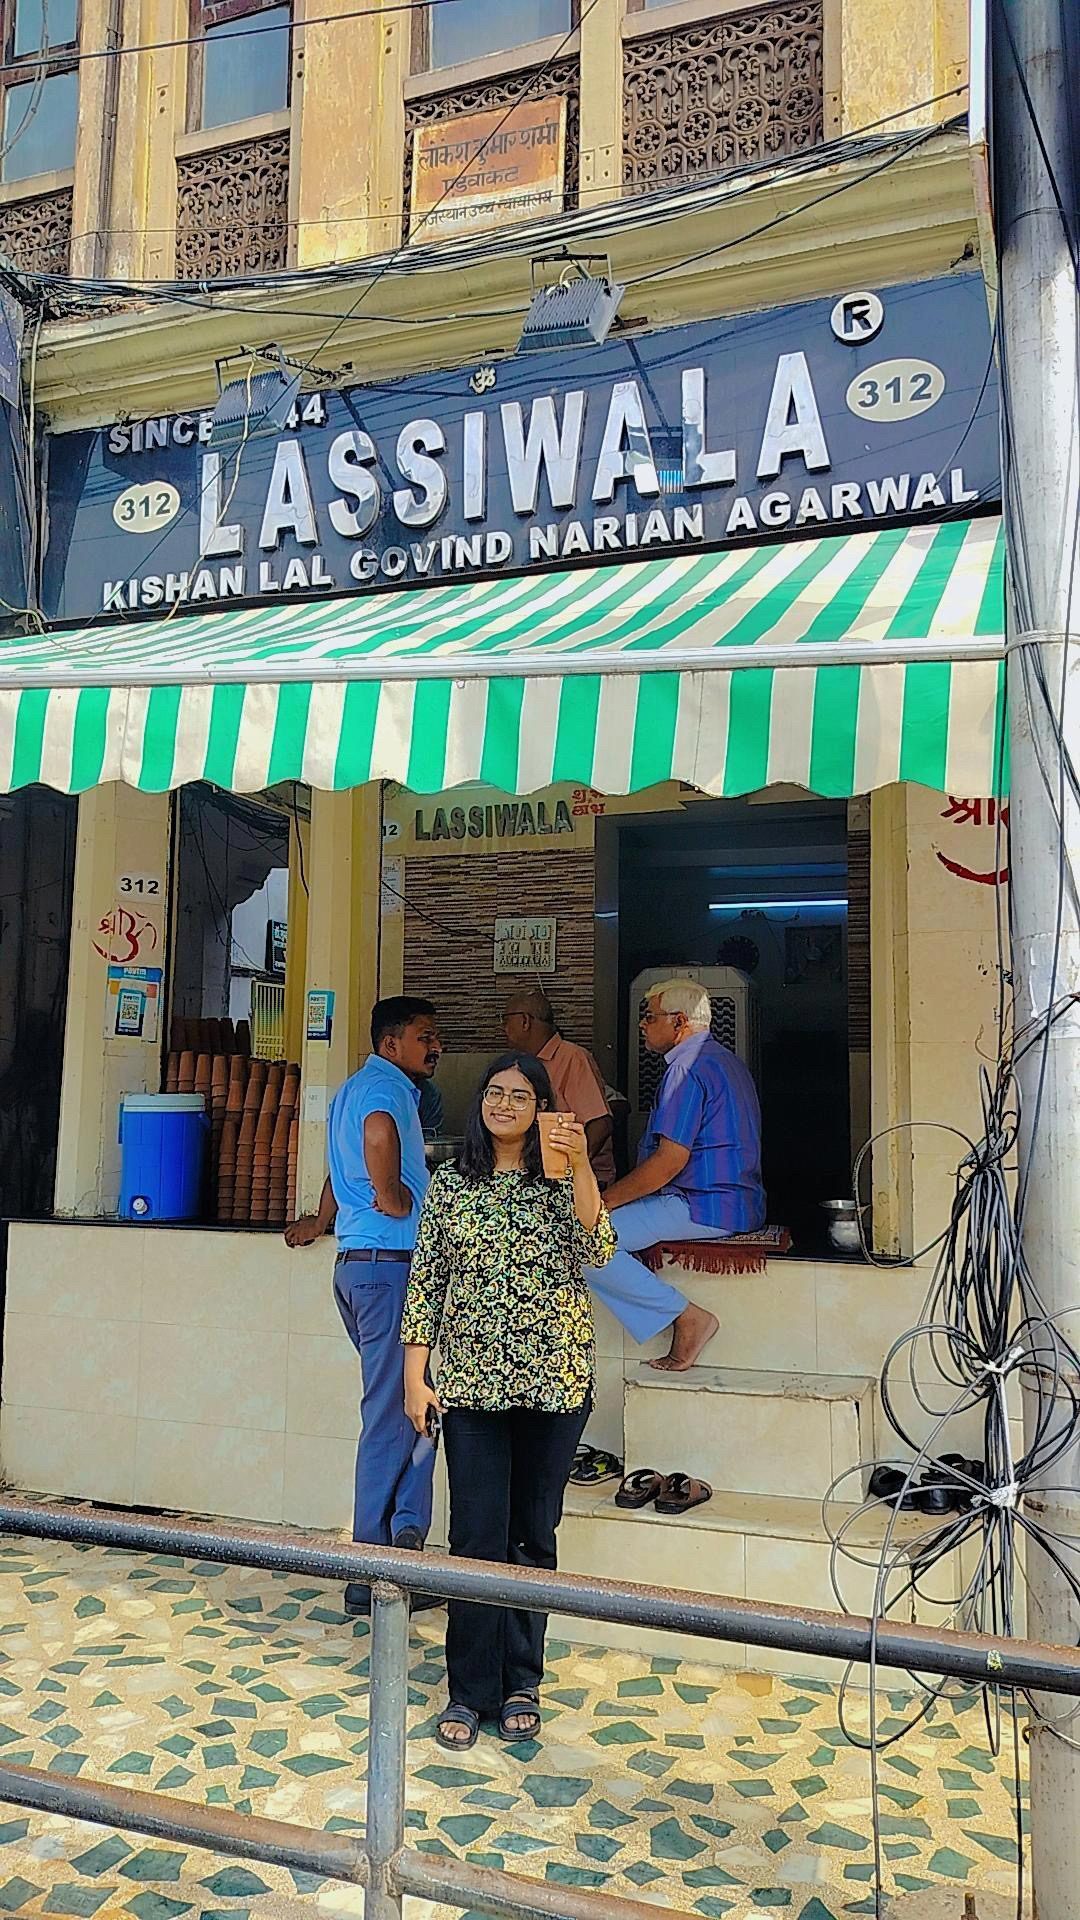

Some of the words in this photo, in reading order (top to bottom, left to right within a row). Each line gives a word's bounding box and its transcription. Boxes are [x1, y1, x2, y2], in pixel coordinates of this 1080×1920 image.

[857, 372, 932, 408] 312
[108, 411, 215, 455] SINCE
[200, 351, 831, 559] LASSIWALA
[120, 492, 171, 521] 312
[102, 564, 246, 612] KISHAN
[258, 555, 334, 593] LAL
[350, 529, 513, 581] GOVIND
[529, 504, 706, 560] NARIAN
[725, 468, 980, 534] AGARWAL
[415, 800, 574, 841] LASSIWALA
[120, 877, 159, 894] 312
